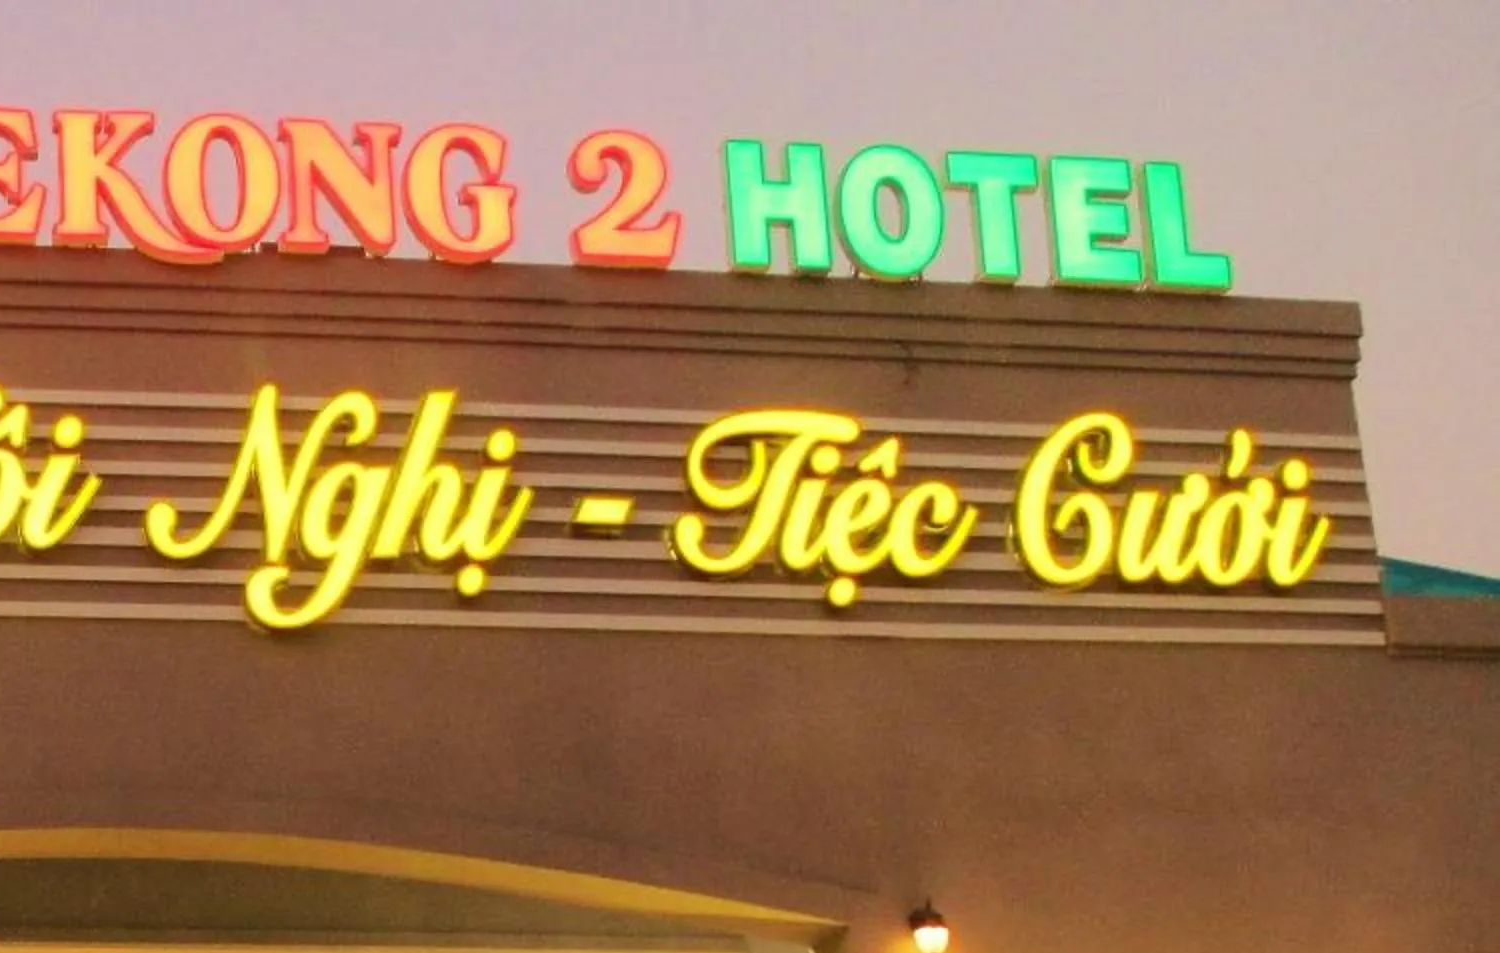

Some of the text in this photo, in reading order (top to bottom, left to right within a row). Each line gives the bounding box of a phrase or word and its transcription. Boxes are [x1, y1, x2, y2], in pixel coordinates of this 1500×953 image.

[564, 127, 687, 269] 2
[722, 136, 1235, 291] HOTEL
[144, 383, 535, 629] Nghị
[570, 496, 634, 535] -
[672, 408, 980, 608] Tiệc
[1014, 411, 1332, 587] Cưới
